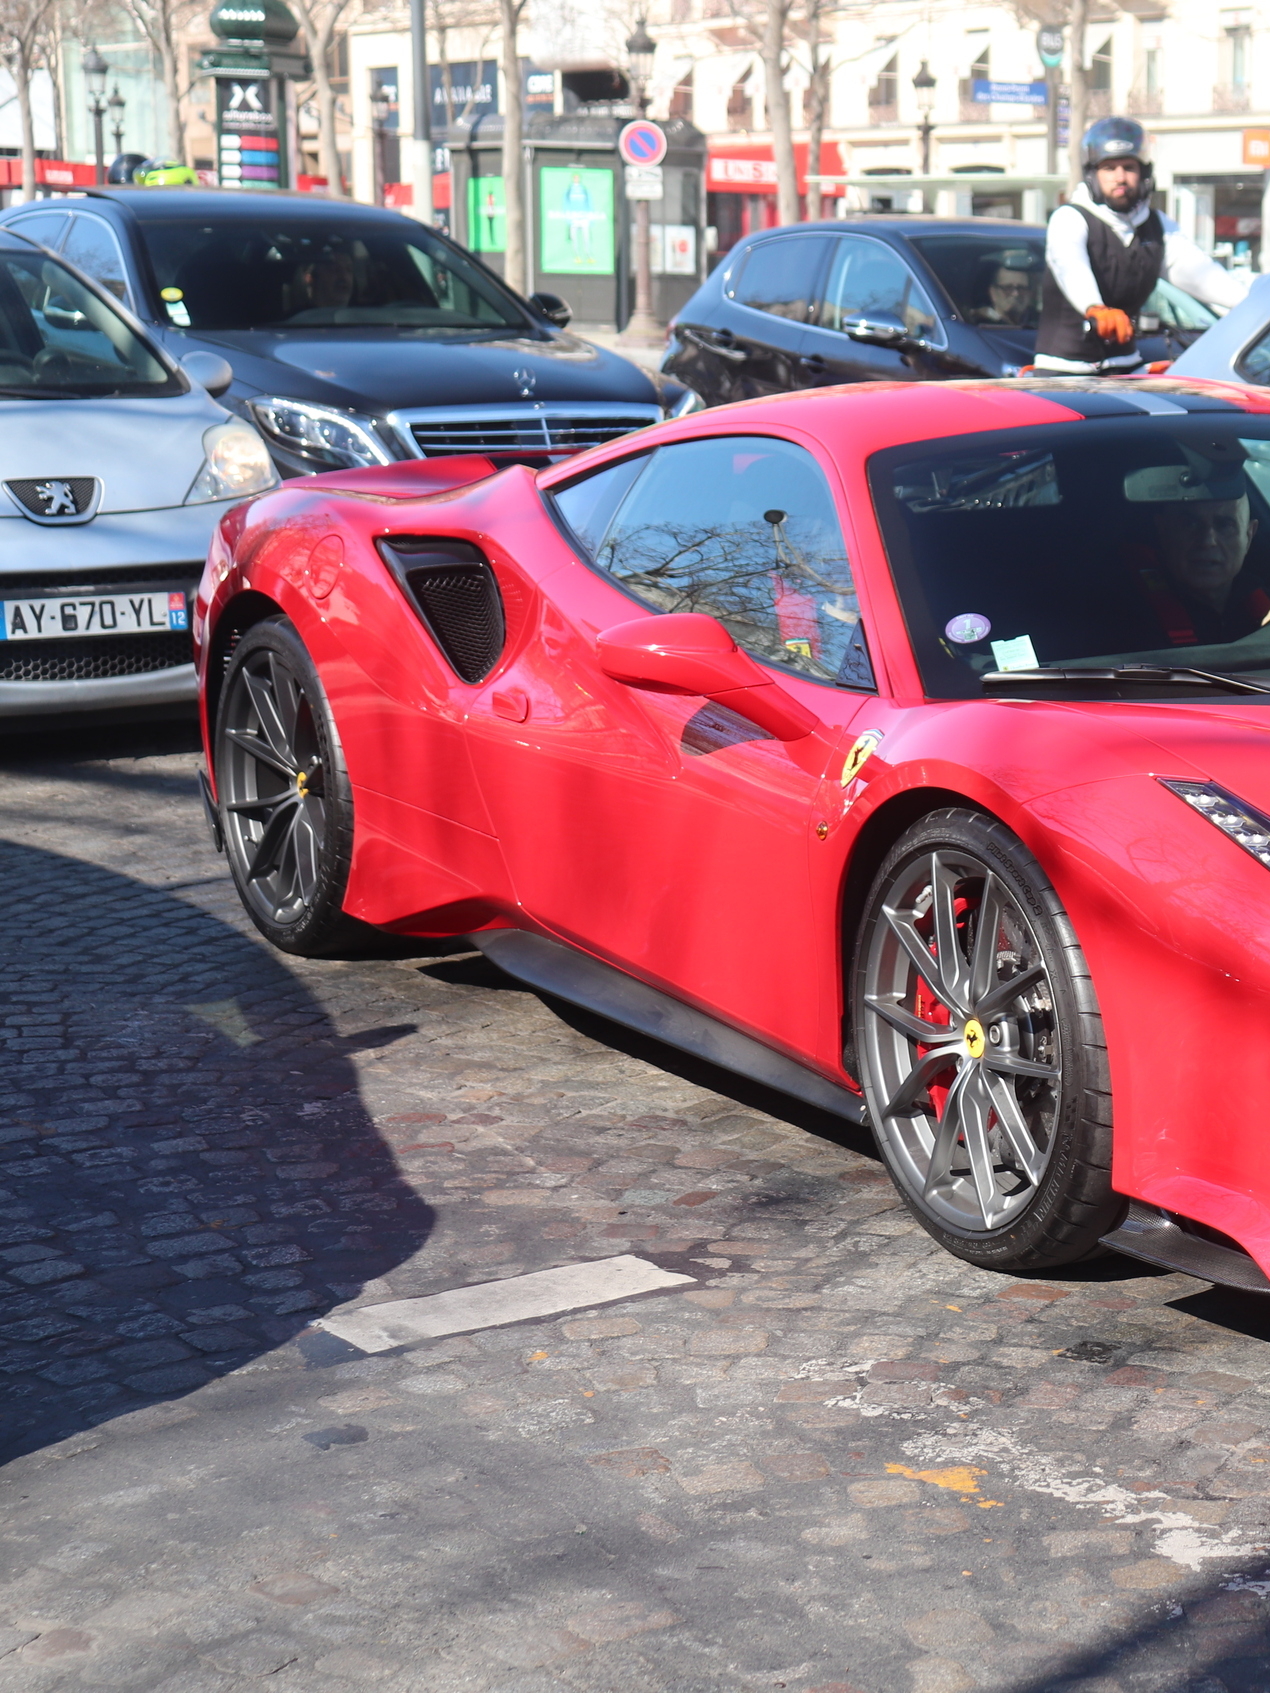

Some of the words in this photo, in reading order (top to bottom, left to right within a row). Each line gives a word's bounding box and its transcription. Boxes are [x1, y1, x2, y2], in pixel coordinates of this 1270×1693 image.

[11, 598, 166, 635] AY-670-YL
[171, 611, 186, 626] 12
[1022, 885, 1037, 906] Cup
[1032, 905, 1043, 916] 2
